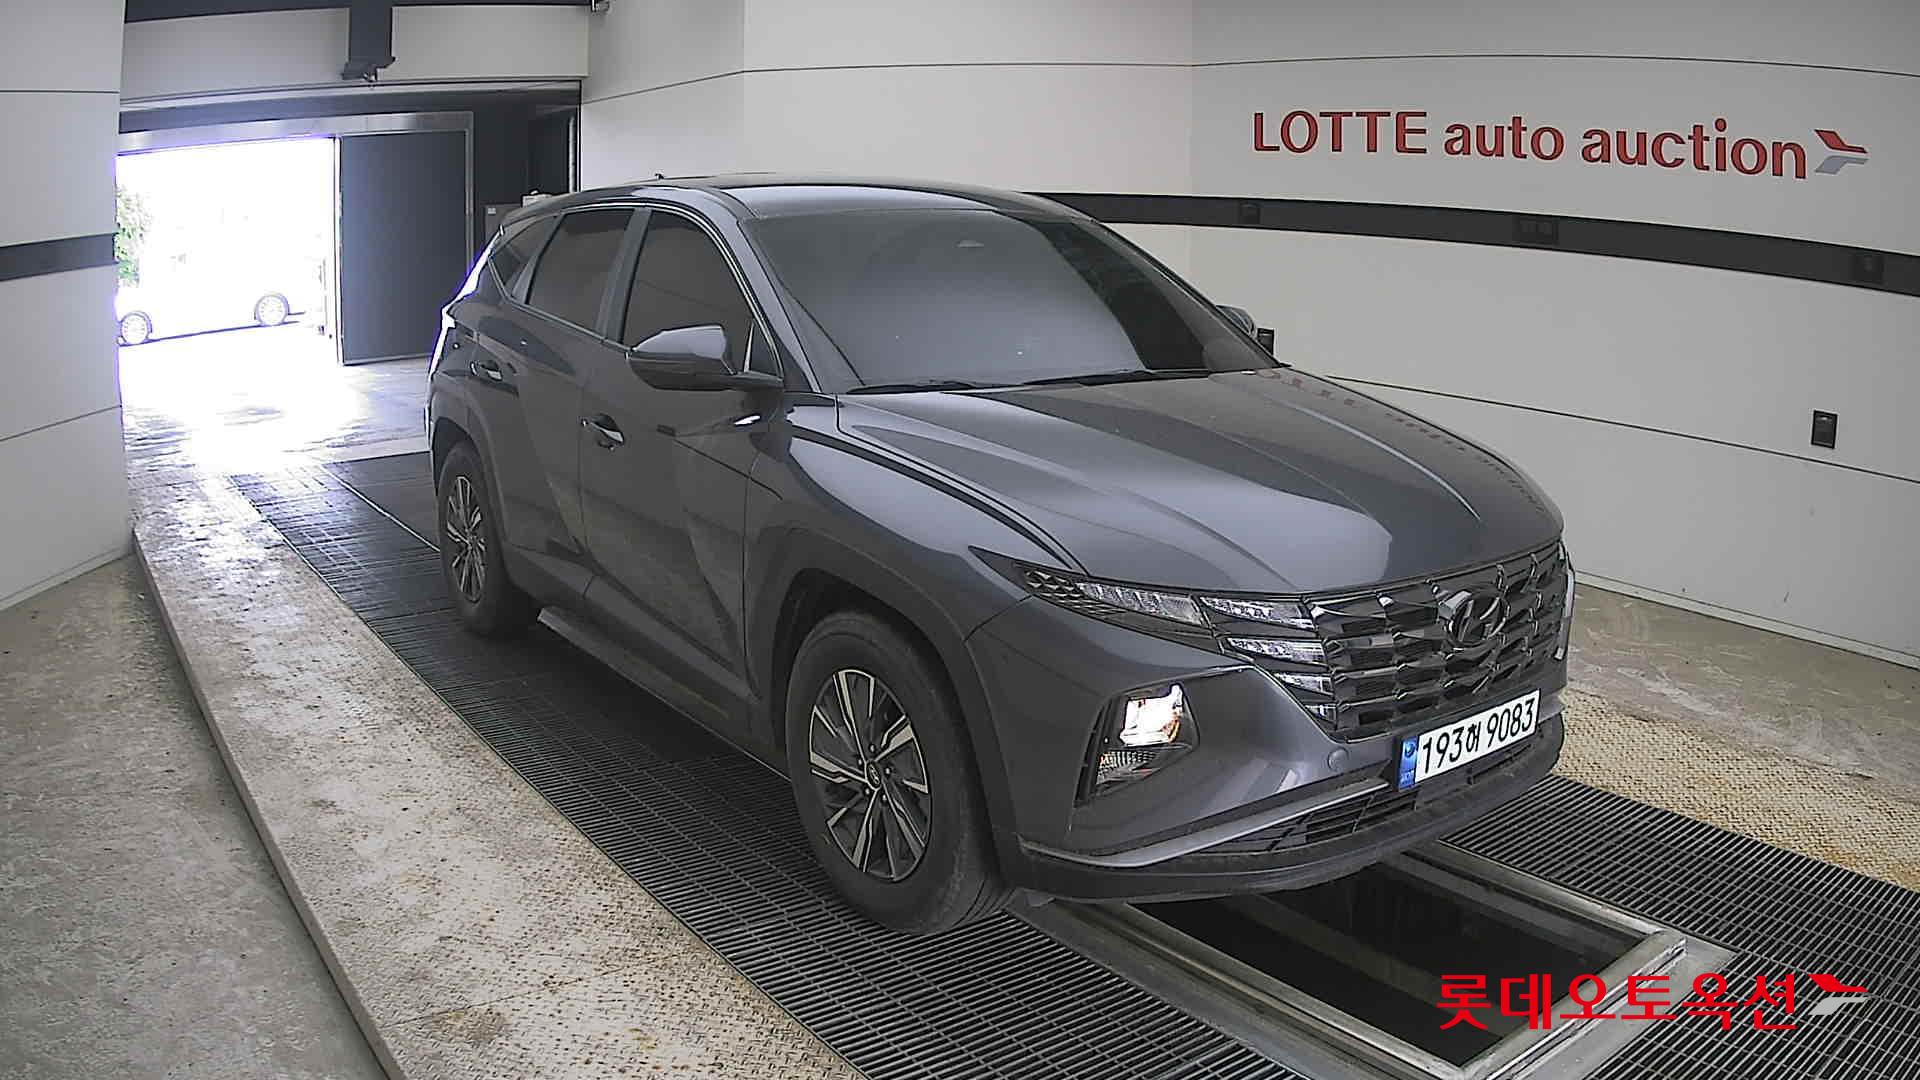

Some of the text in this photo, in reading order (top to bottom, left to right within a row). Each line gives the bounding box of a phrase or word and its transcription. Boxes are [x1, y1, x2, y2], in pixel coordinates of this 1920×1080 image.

[1254, 111, 1807, 179] LOTTE auto auction
[1486, 697, 1536, 748] 9083
